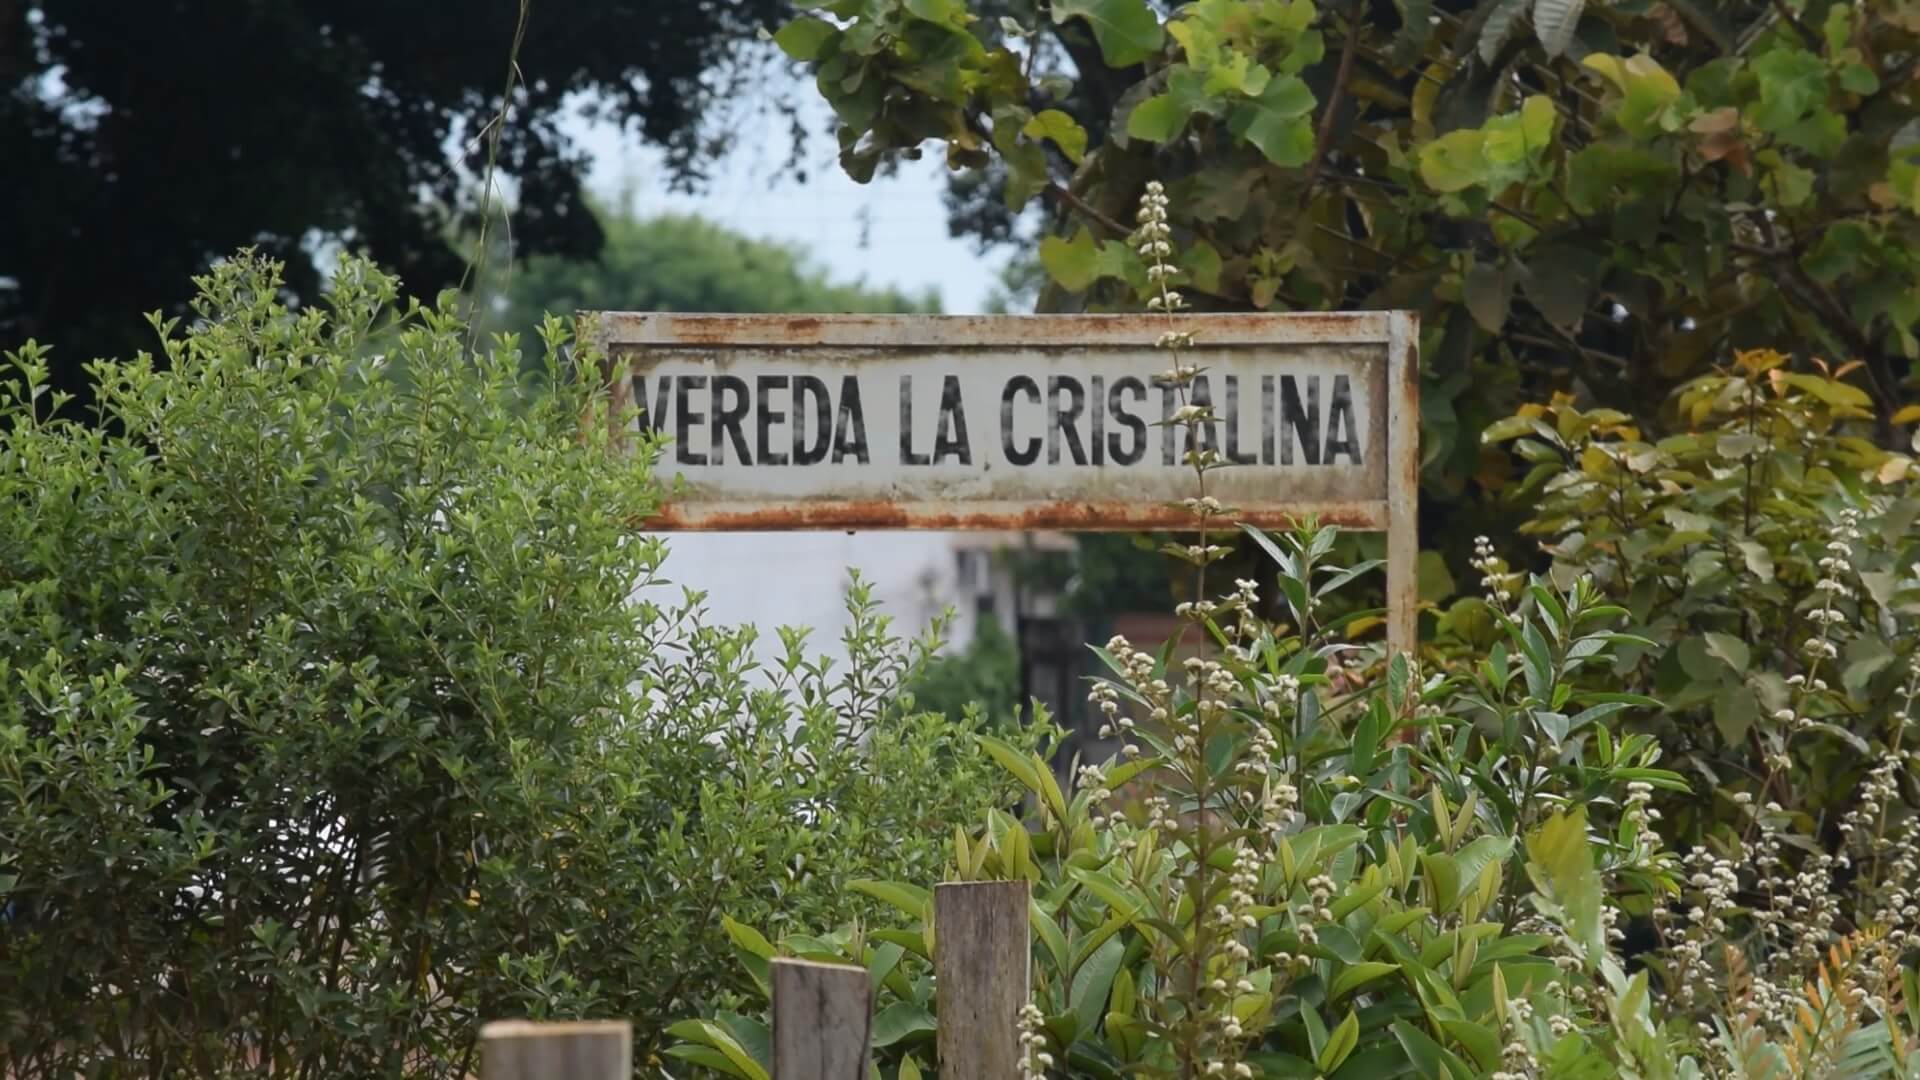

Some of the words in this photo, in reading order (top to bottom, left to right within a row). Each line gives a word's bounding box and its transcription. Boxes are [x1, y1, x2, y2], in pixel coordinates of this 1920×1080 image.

[632, 375, 870, 466] VEREDA
[900, 375, 972, 466] LA
[1001, 374, 1362, 466] CRISTALINA
